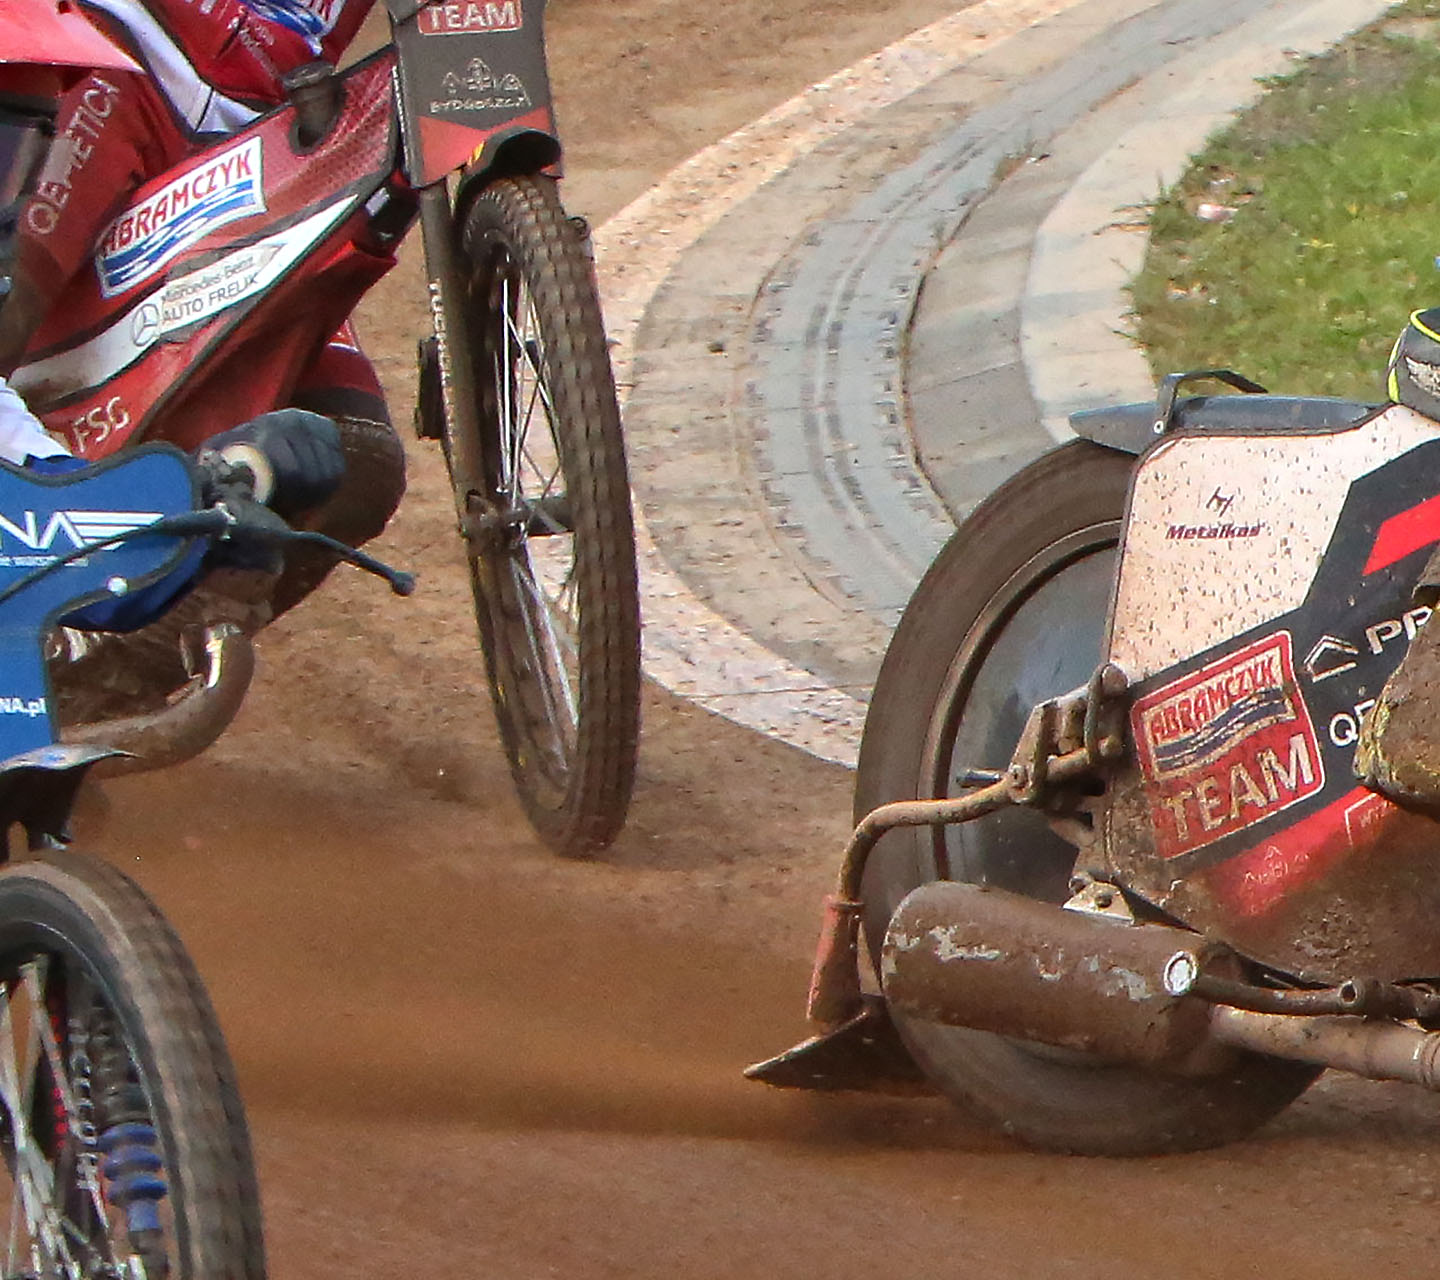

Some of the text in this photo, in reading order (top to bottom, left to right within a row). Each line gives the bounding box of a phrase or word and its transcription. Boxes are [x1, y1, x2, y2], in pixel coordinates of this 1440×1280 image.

[428, 0, 515, 29] TEAM
[102, 148, 253, 258] ABRAMCZYK
[163, 298, 204, 320] AUTO
[1165, 523, 1262, 540] Metalkas
[1151, 655, 1277, 743] ABRAMCZYK
[1160, 732, 1314, 842] TEAM
